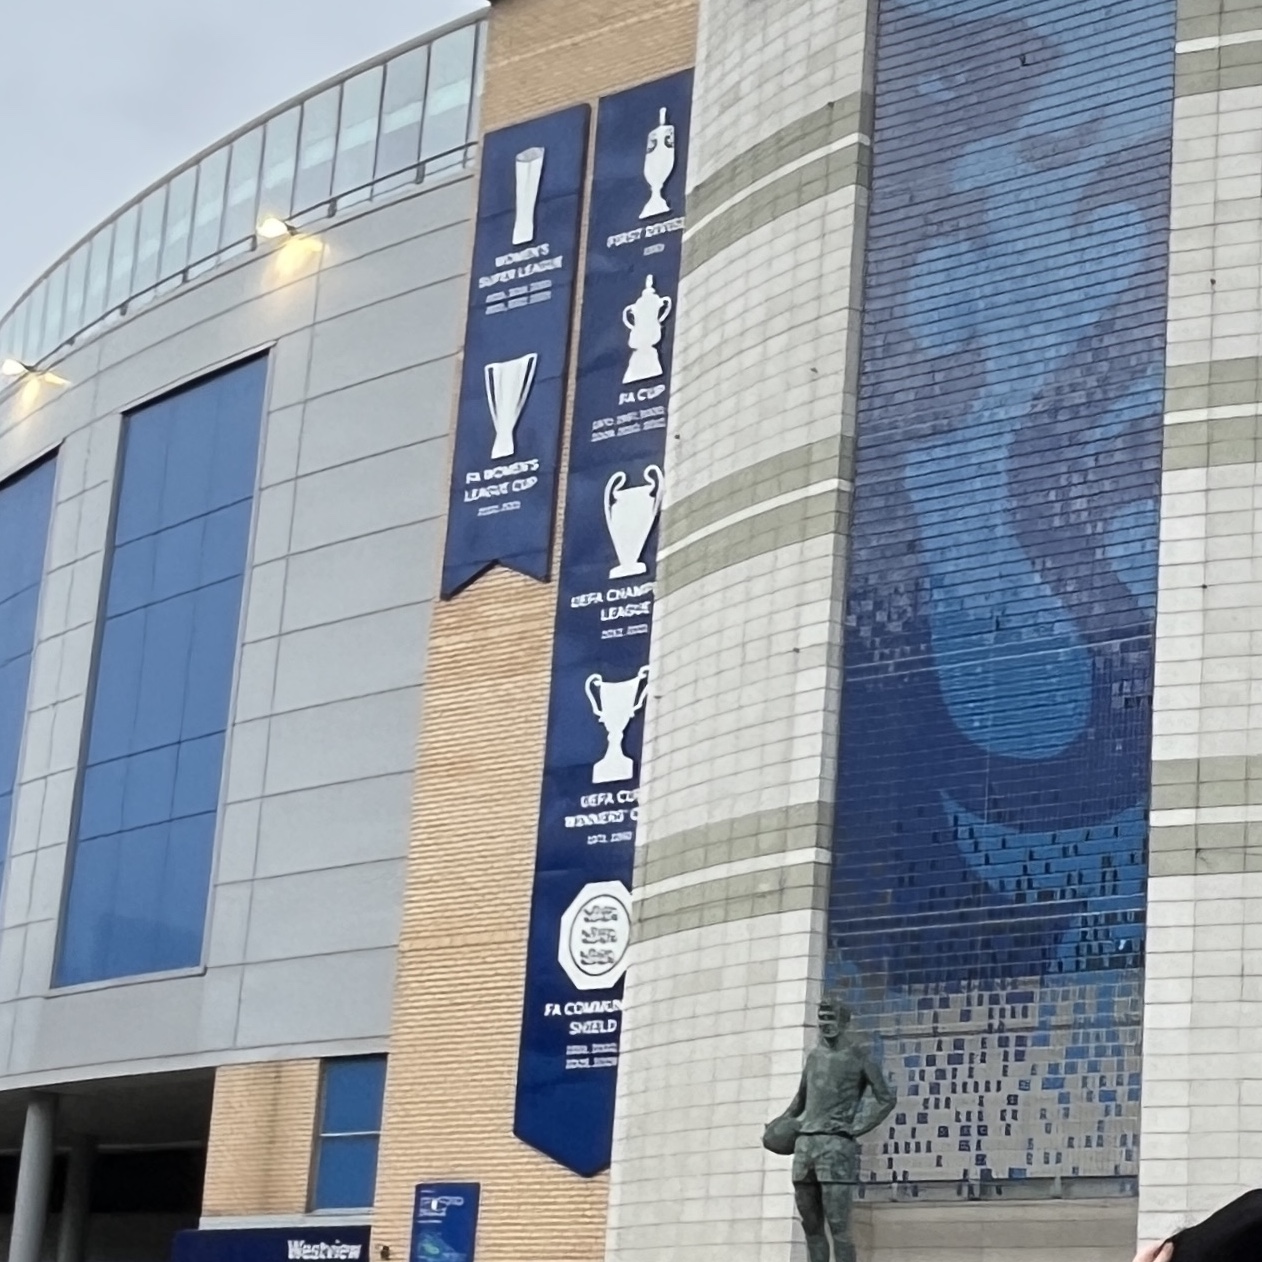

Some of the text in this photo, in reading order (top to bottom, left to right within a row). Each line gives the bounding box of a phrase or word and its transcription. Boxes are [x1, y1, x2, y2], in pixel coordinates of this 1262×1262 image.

[618, 384, 666, 405] FA CUP
[617, 790, 640, 803] CU
[544, 1003, 561, 1016] FA
[287, 1239, 362, 1260] Westview
